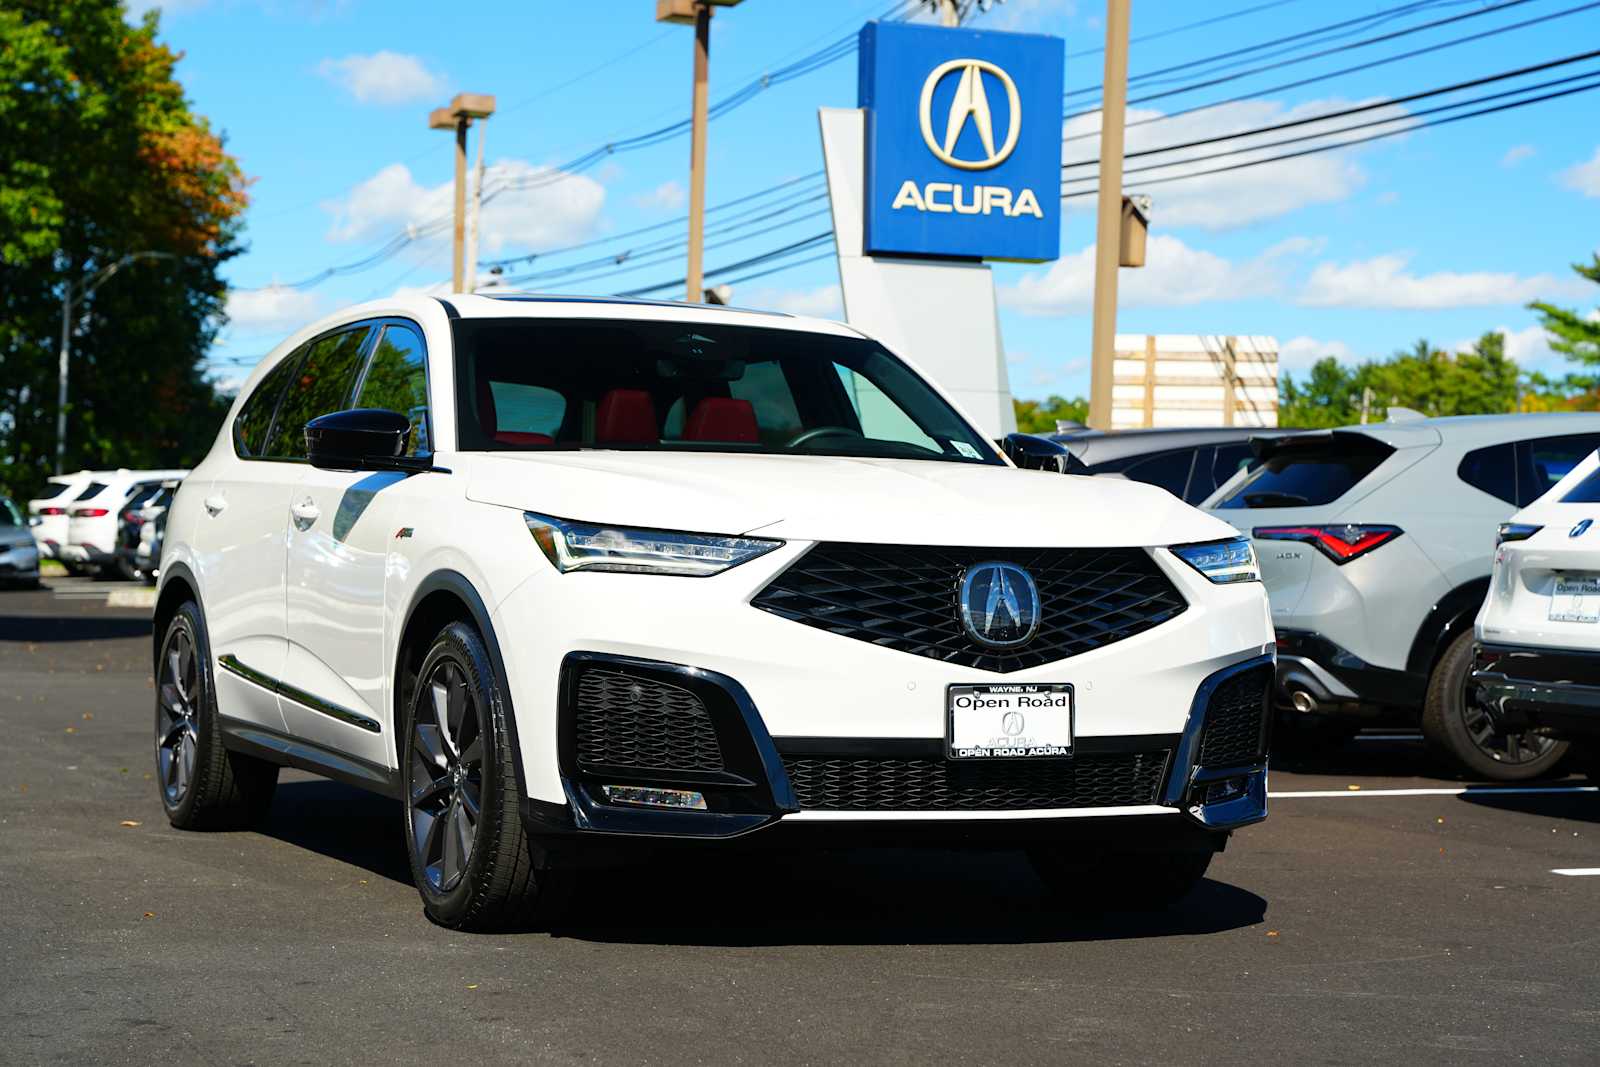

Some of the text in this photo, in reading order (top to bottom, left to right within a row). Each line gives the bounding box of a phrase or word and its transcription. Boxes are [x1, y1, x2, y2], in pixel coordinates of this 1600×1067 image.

[892, 180, 1044, 218] ACURA
[956, 696, 1067, 711] Open Road
[959, 746, 1067, 757] OPEN ROAD ACURA
